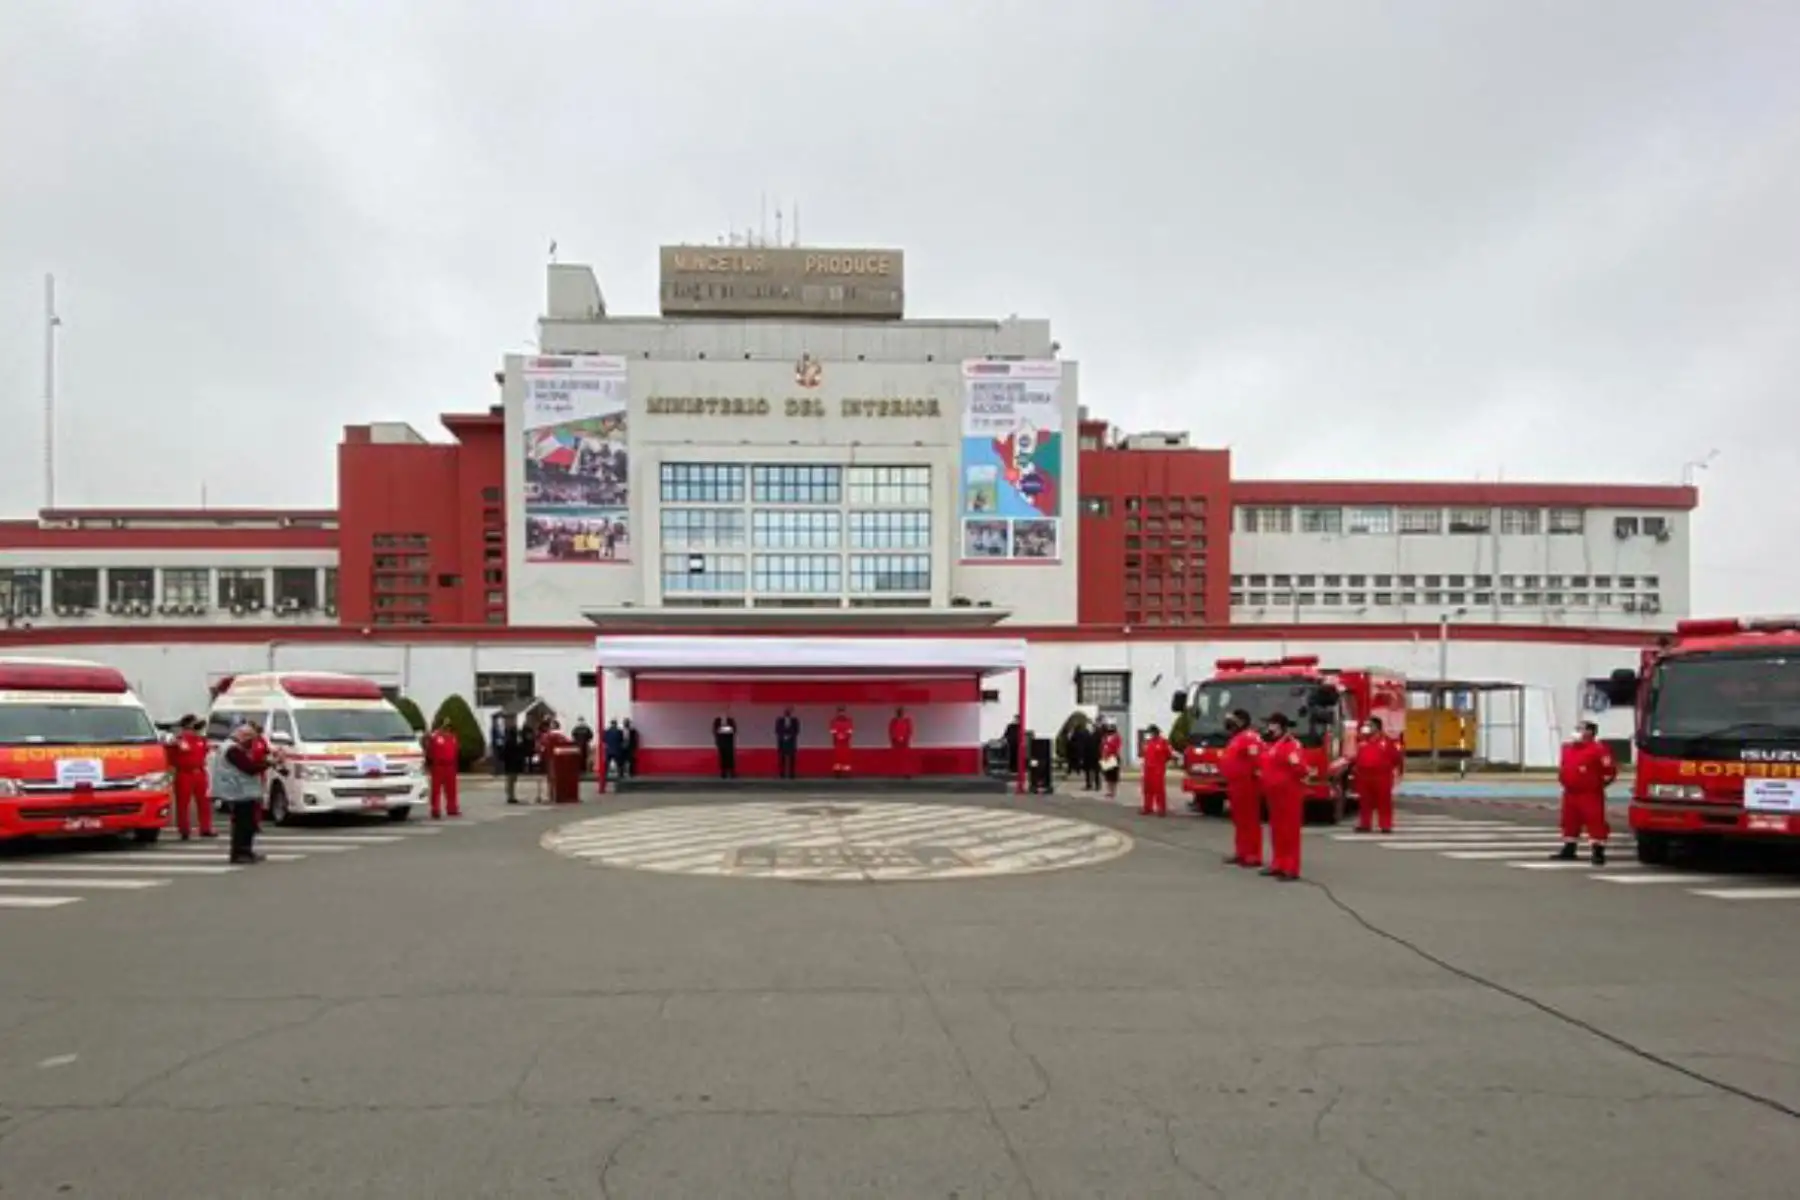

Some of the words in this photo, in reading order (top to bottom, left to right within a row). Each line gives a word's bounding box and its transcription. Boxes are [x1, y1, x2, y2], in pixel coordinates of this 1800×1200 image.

[804, 255, 891, 275] PRODUCE
[646, 397, 771, 415] MINISTERIO
[784, 397, 826, 417] DEL
[840, 398, 941, 418] INTERIOR
